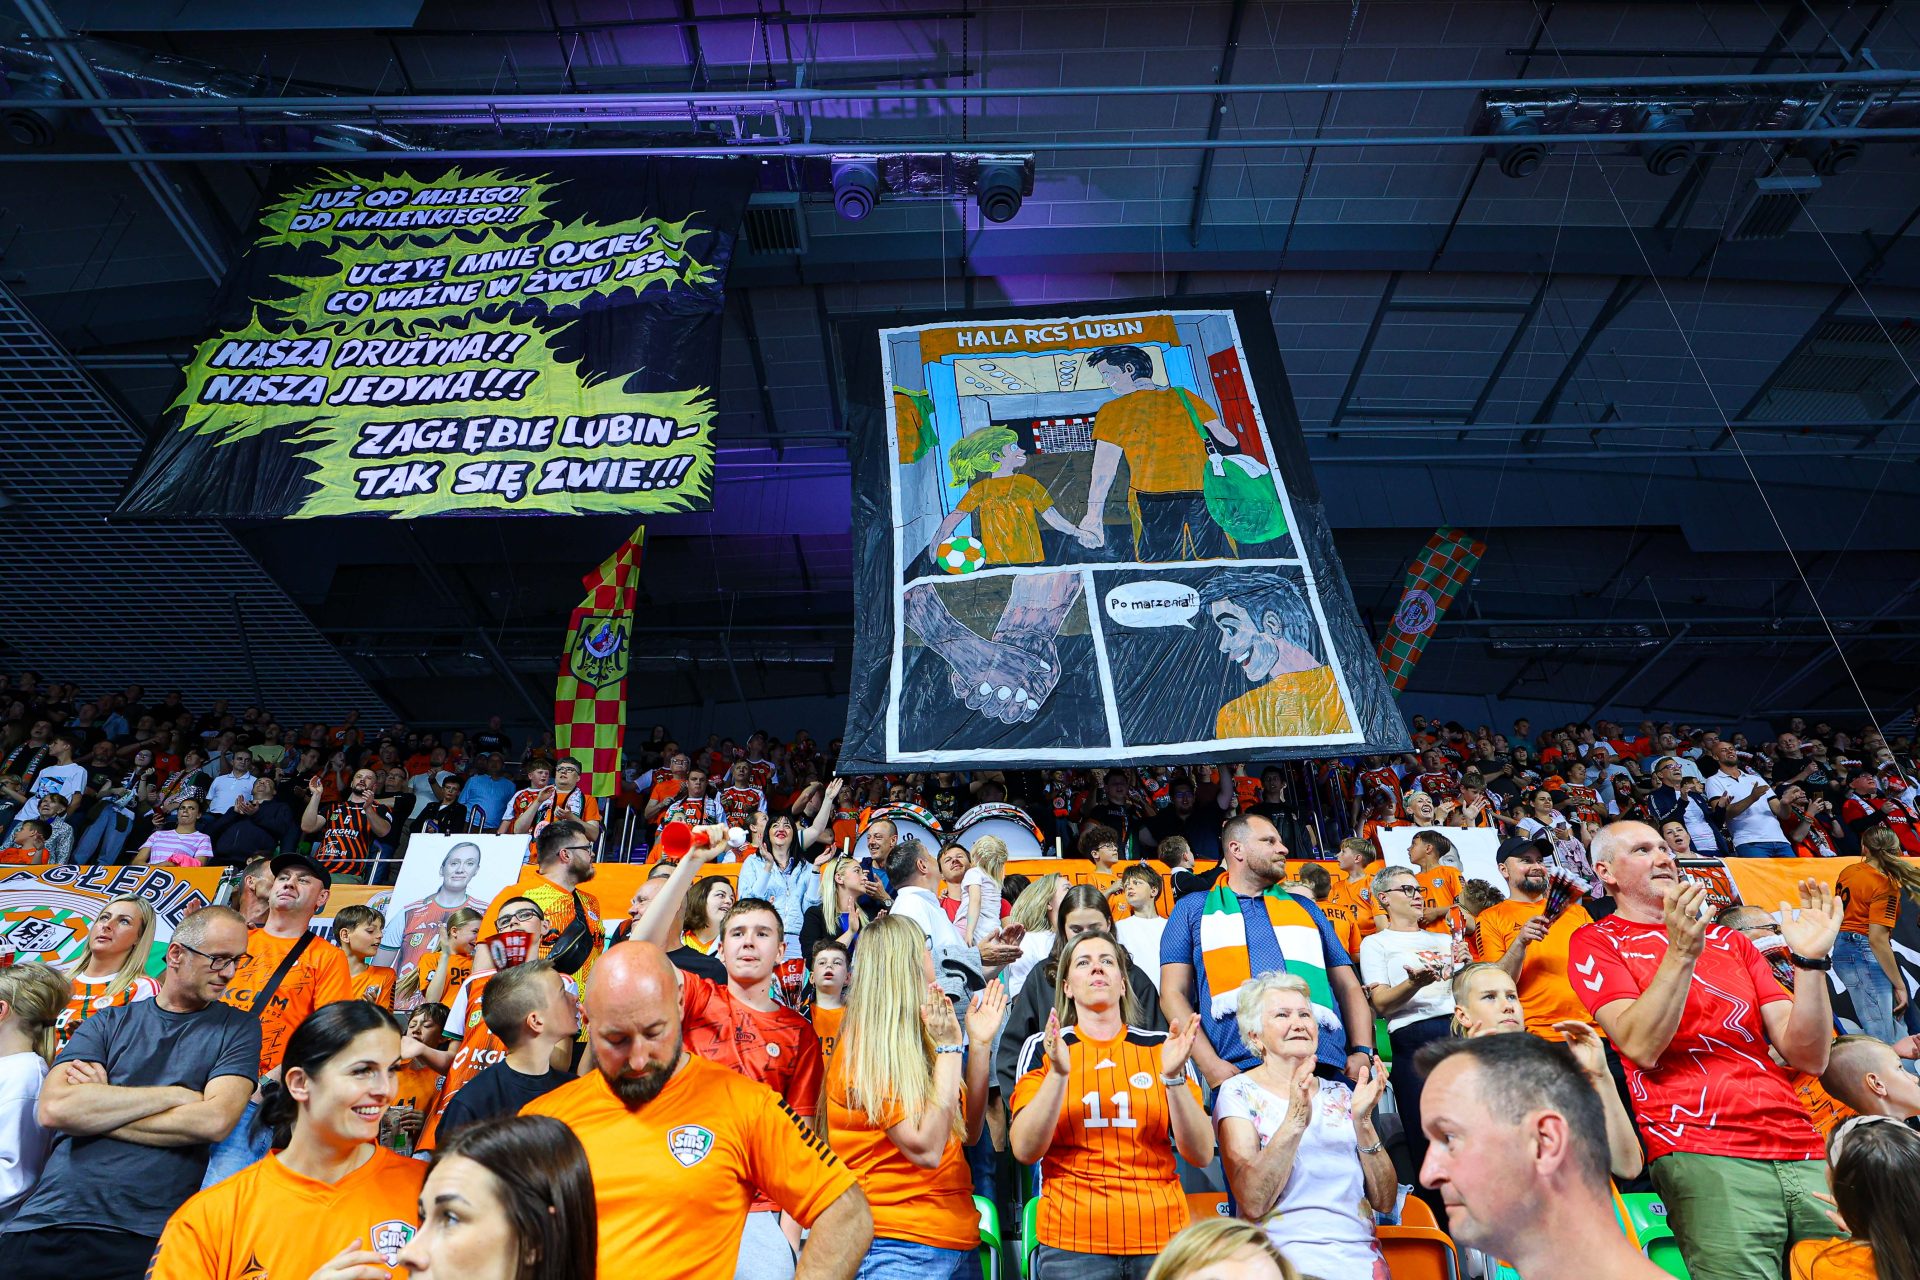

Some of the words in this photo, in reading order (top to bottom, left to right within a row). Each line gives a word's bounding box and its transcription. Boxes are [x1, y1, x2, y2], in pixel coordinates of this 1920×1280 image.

[300, 185, 363, 210] JUŻ
[365, 189, 408, 207] OD
[410, 186, 528, 206] MAŁEGO!
[290, 213, 332, 232] OD
[348, 261, 445, 285] UCZYŁ
[459, 246, 540, 274] MNIE
[328, 291, 371, 312] CO
[376, 281, 482, 309] WAŻNE
[486, 276, 520, 299] W
[523, 261, 612, 293] ŻYCIU
[212, 339, 331, 368] NASZA
[334, 333, 528, 367] DRUŻYNA!!
[957, 328, 1019, 347] HALA
[1024, 325, 1069, 345] RCS
[1072, 320, 1143, 341] LUBIN
[203, 376, 328, 402] NASZA
[329, 368, 536, 404] JEDYNA!!!
[357, 418, 556, 455] ZAGŁĘBIE
[358, 463, 439, 496] TAK
[455, 462, 528, 500] SIĘ
[538, 456, 695, 491] ZWIE!!!
[1111, 598, 1128, 610] Po
[331, 828, 359, 838] KGHM
[1081, 1090, 1138, 1129] 11
[1652, 1204, 1663, 1214] 17
